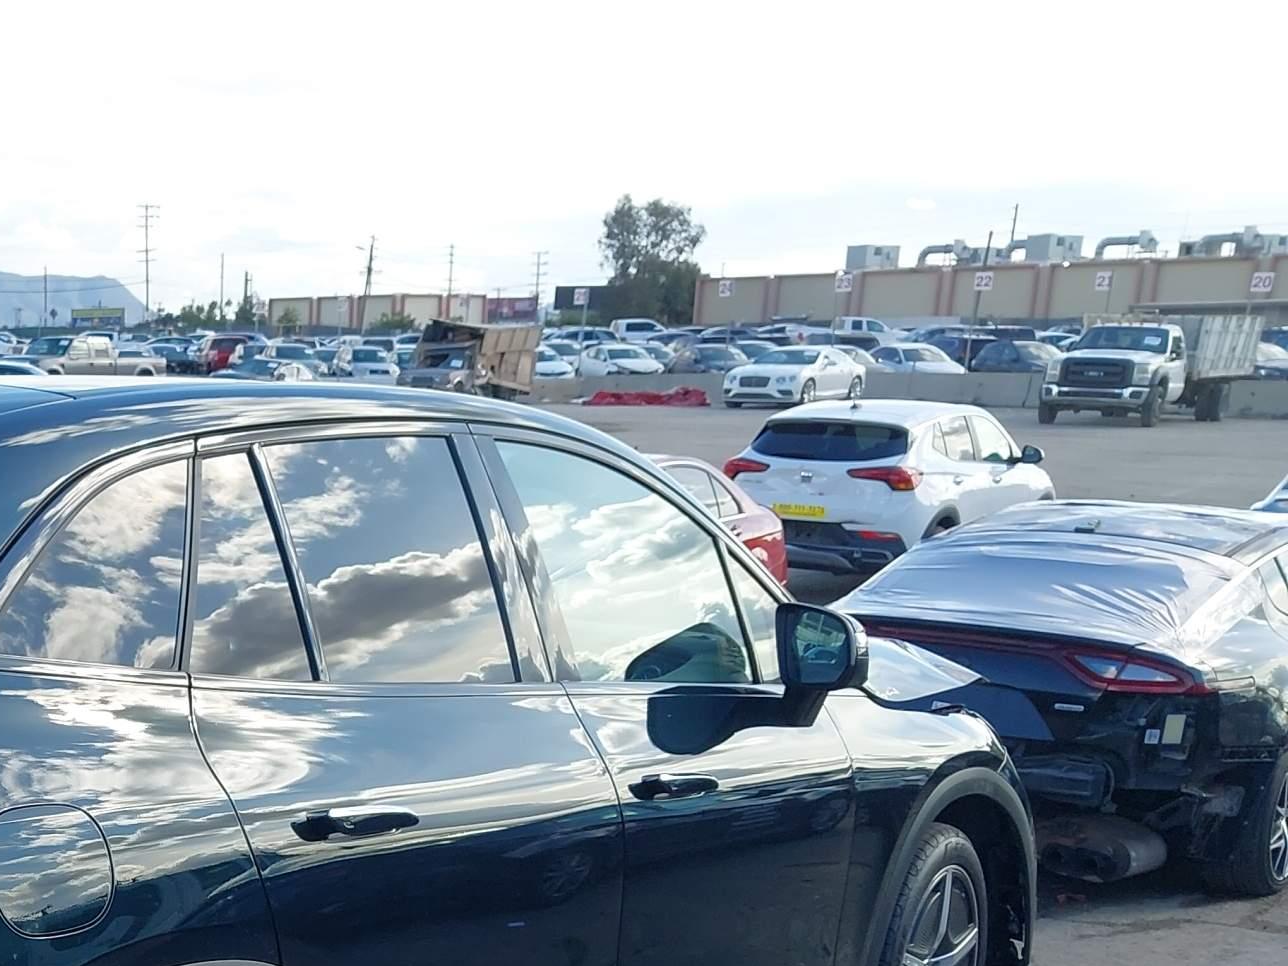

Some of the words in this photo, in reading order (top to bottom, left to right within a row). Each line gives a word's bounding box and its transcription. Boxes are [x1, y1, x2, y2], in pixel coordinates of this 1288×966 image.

[835, 276, 852, 289] 23
[975, 275, 993, 287] 22
[1096, 275, 1112, 288] 21
[1252, 275, 1272, 289] 20
